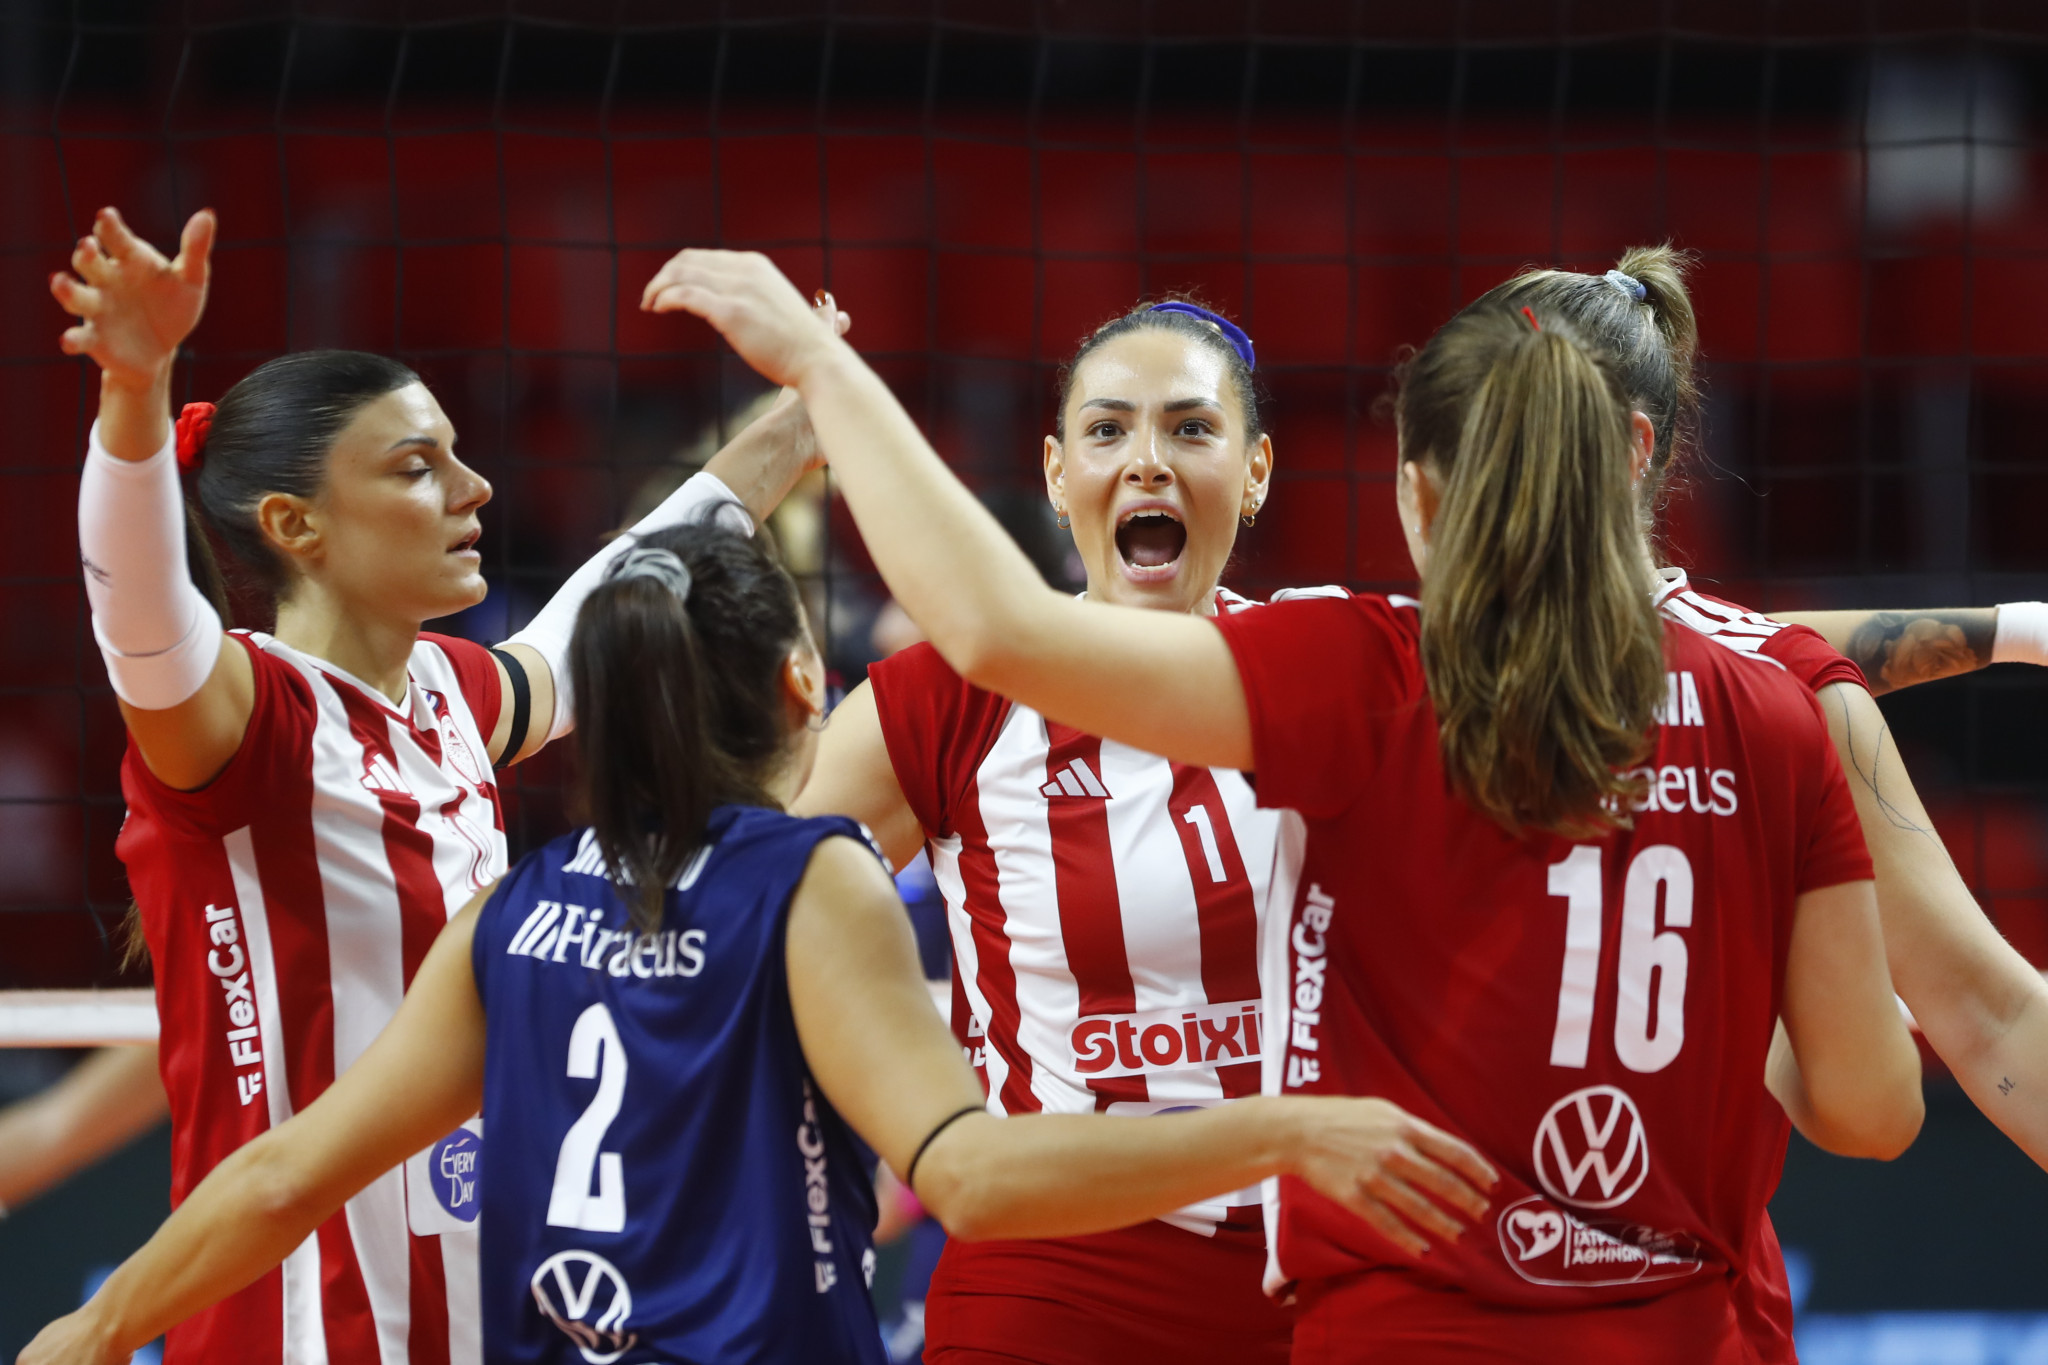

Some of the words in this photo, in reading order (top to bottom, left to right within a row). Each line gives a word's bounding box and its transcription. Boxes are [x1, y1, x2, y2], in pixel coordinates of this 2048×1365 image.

[1183, 804, 1228, 882] 1
[1600, 765, 1738, 816] aeus
[205, 904, 263, 1067] FlexCar
[1071, 1005, 1264, 1073] Stoixi
[1292, 883, 1335, 1051] FlexCar
[1547, 845, 1694, 1073] 16
[546, 1002, 628, 1233] 2
[797, 1077, 834, 1254] FlexC
